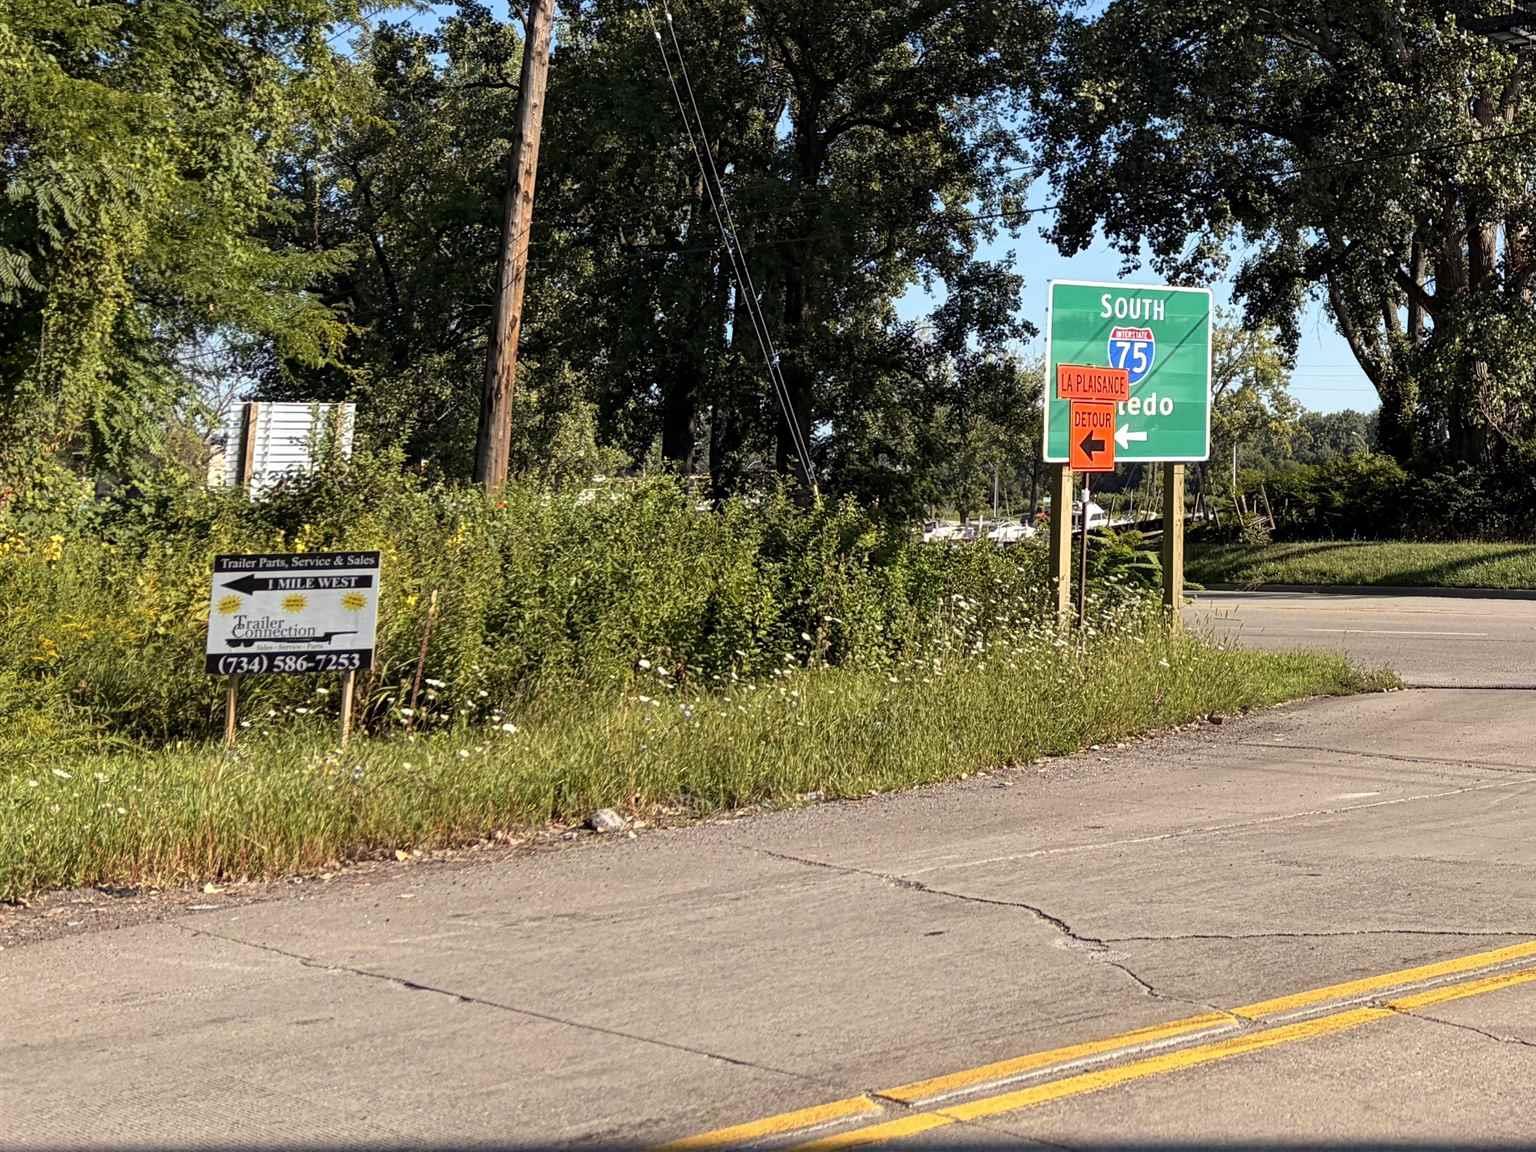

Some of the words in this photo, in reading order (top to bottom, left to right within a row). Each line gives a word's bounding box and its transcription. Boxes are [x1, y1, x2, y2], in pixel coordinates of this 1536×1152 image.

[1100, 294, 1165, 321] SOUTH
[1116, 341, 1148, 373] 75
[1061, 374, 1073, 392] LA
[1076, 374, 1125, 394] PLAISANCE
[1118, 392, 1174, 416] ledo
[1075, 411, 1111, 428] DETOUR
[221, 558, 257, 569] Trailer
[259, 557, 289, 568] Parts,
[291, 556, 331, 567] Service
[333, 555, 344, 566] &
[346, 555, 375, 566] Sales
[277, 578, 315, 590] MILE
[318, 577, 358, 589] WEST
[231, 623, 316, 639] Connection
[233, 614, 285, 630] Trailer
[218, 655, 268, 673] (734)
[273, 654, 360, 672] 586-7253
